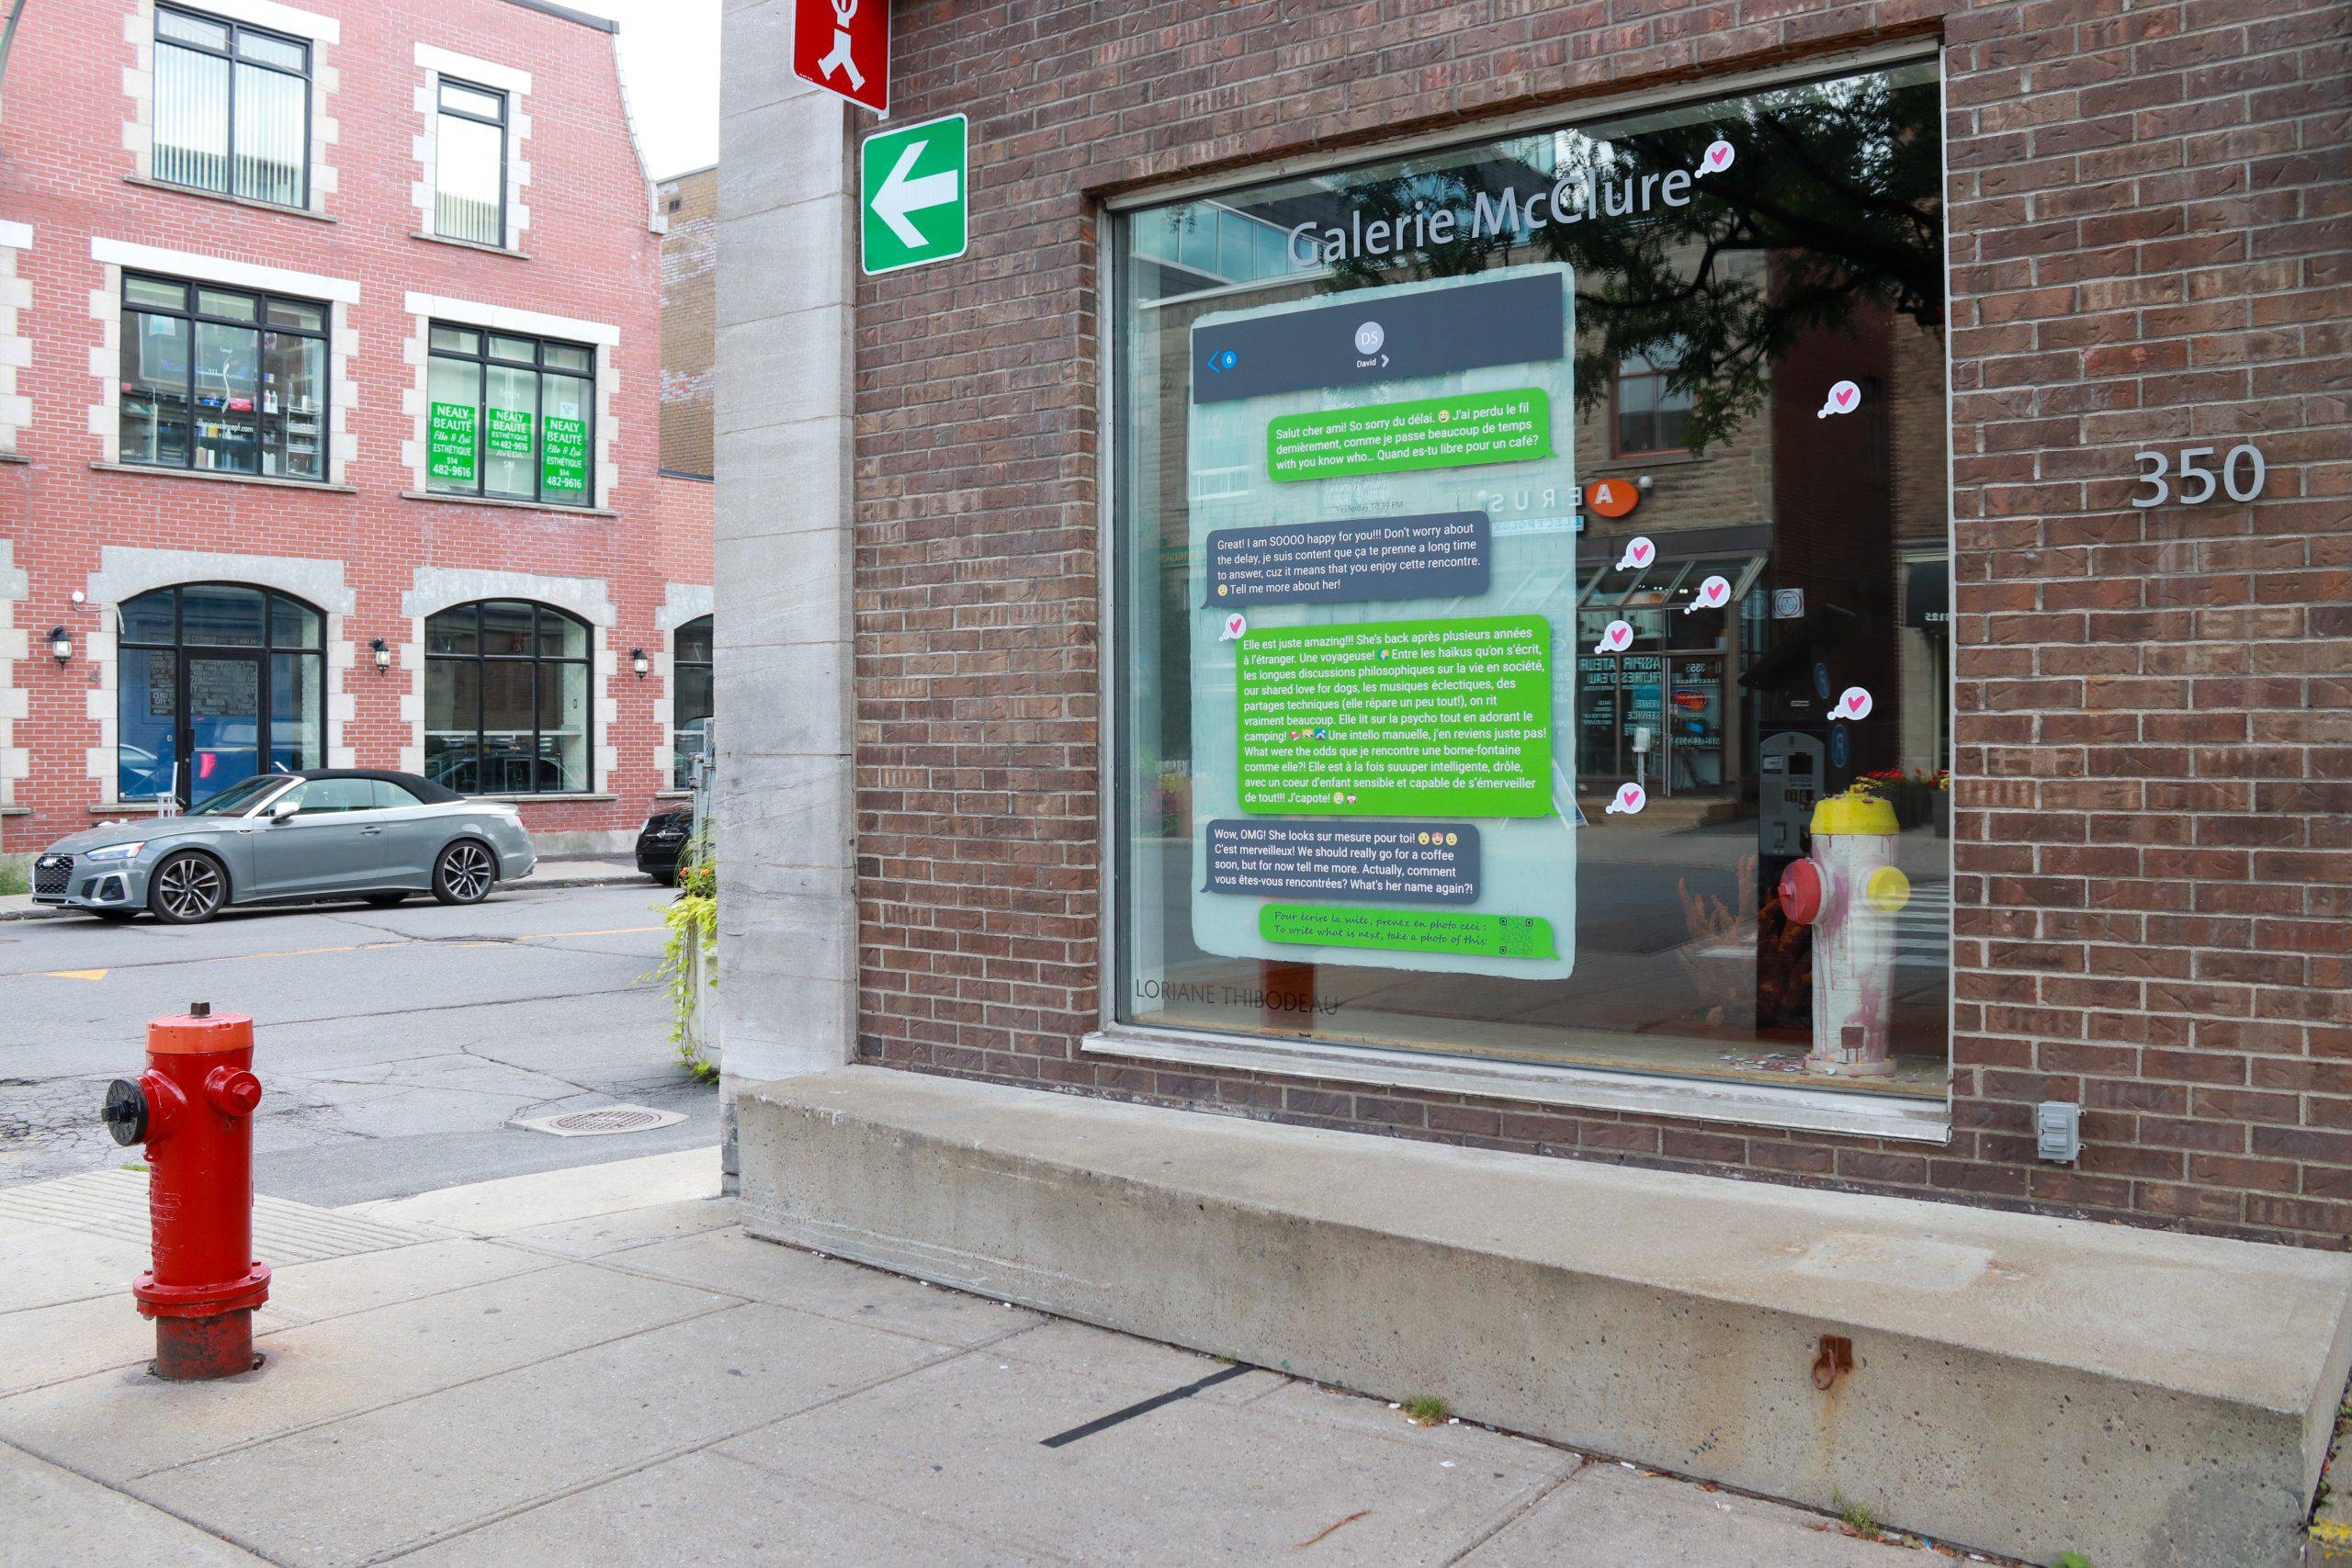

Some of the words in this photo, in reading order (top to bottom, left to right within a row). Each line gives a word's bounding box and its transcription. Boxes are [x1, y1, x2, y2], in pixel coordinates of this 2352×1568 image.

[1288, 201, 1454, 269] Galerie
[1470, 166, 1692, 240] McClure
[1361, 331, 1379, 345] DS
[1226, 355, 1232, 364] 6
[1356, 358, 1376, 368] David
[437, 406, 469, 419] NEALY
[496, 411, 524, 423] NEALY
[1276, 427, 1300, 439] Salut
[1302, 425, 1323, 436] cher
[1326, 422, 1347, 434] ami!
[1349, 421, 1363, 432] So
[1364, 419, 1390, 430] sorry
[1392, 415, 1406, 426] du
[1408, 412, 1435, 425] délai.
[1473, 405, 1504, 421] perdu
[1506, 404, 1516, 414] le
[1519, 401, 1529, 413] fil
[434, 418, 472, 433] BEAUTÉ
[550, 420, 580, 433] NEALY
[547, 432, 582, 446] BEAUTÉ
[1275, 439, 1341, 455] dernièrement,
[1343, 435, 1382, 447] comme
[1383, 433, 1393, 446] je
[1395, 432, 1426, 445] passe
[1428, 425, 1479, 439] beaucoup
[1482, 423, 1496, 434] de
[1498, 421, 1532, 433] temps
[500, 441, 528, 451] 482-9616
[1276, 458, 1296, 469] with
[1298, 458, 1316, 470] you
[1318, 455, 1344, 466] know
[1377, 446, 1410, 461] Quand
[1412, 446, 1438, 457] es-tu
[1441, 442, 1464, 454] libre
[1465, 441, 1490, 454] pour
[1492, 439, 1506, 449] un
[1509, 434, 1539, 447] café?
[433, 465, 471, 478] 482-9616
[2132, 445, 2267, 509] 350
[547, 477, 582, 489] 482-9616
[1217, 538, 1245, 550] Great!
[1247, 538, 1250, 547] I
[1252, 538, 1267, 547] am
[1269, 534, 1305, 547] SOOOO
[1306, 533, 1337, 546] happy
[1339, 530, 1353, 541] for
[1354, 528, 1381, 543] you!!!
[1412, 526, 1442, 537] worry
[1443, 523, 1474, 535] about
[1229, 583, 1247, 594] Tell
[1249, 585, 1263, 593] me
[1265, 583, 1290, 592] more
[1292, 580, 1319, 591] about
[1322, 579, 1340, 590] her!
[1243, 638, 1261, 650] Elle
[1261, 639, 1277, 649] est
[1278, 637, 1302, 650] juste
[1304, 635, 1354, 649] amazing!!!
[1385, 632, 1409, 644] back
[1411, 631, 1441, 644] après
[1442, 630, 1491, 644] plusieurs
[1493, 626, 1532, 639] années
[1244, 730, 1287, 743] camping!
[1328, 729, 1348, 740] Une
[1349, 728, 1380, 740] intello
[1382, 728, 1430, 740] manuelle,
[1453, 728, 1492, 739] reviens
[1494, 728, 1521, 741] juste
[1523, 727, 1546, 740] pas!
[1244, 746, 1268, 757] What
[1270, 748, 1294, 756] were
[1295, 745, 1311, 756] the
[1313, 745, 1338, 756] odds
[1339, 748, 1358, 758] que
[1359, 746, 1369, 758] je
[1371, 746, 1419, 756] rencontre
[1422, 747, 1442, 755] une
[1443, 743, 1521, 755] borne-fontaine
[1244, 792, 1256, 803] de
[1258, 792, 1285, 803] tout!!!
[1214, 829, 1238, 840] Wow,
[1240, 829, 1266, 840] OMG!
[1268, 829, 1286, 840] She
[1288, 829, 1315, 841] looks
[1317, 832, 1332, 841] sur
[1334, 833, 1372, 842] mesure
[1374, 834, 1397, 845] pour
[1398, 832, 1415, 843] toi!
[1215, 875, 1237, 885] vous
[1238, 874, 1283, 886] êtes-vous
[1285, 877, 1348, 889] rencontrées?
[1385, 879, 1402, 891] her
[1404, 883, 1433, 893] name
[1435, 883, 1473, 896] again?!
[1136, 979, 1216, 1004] LORIANE
[1220, 986, 1339, 1015] THIBODEAU
